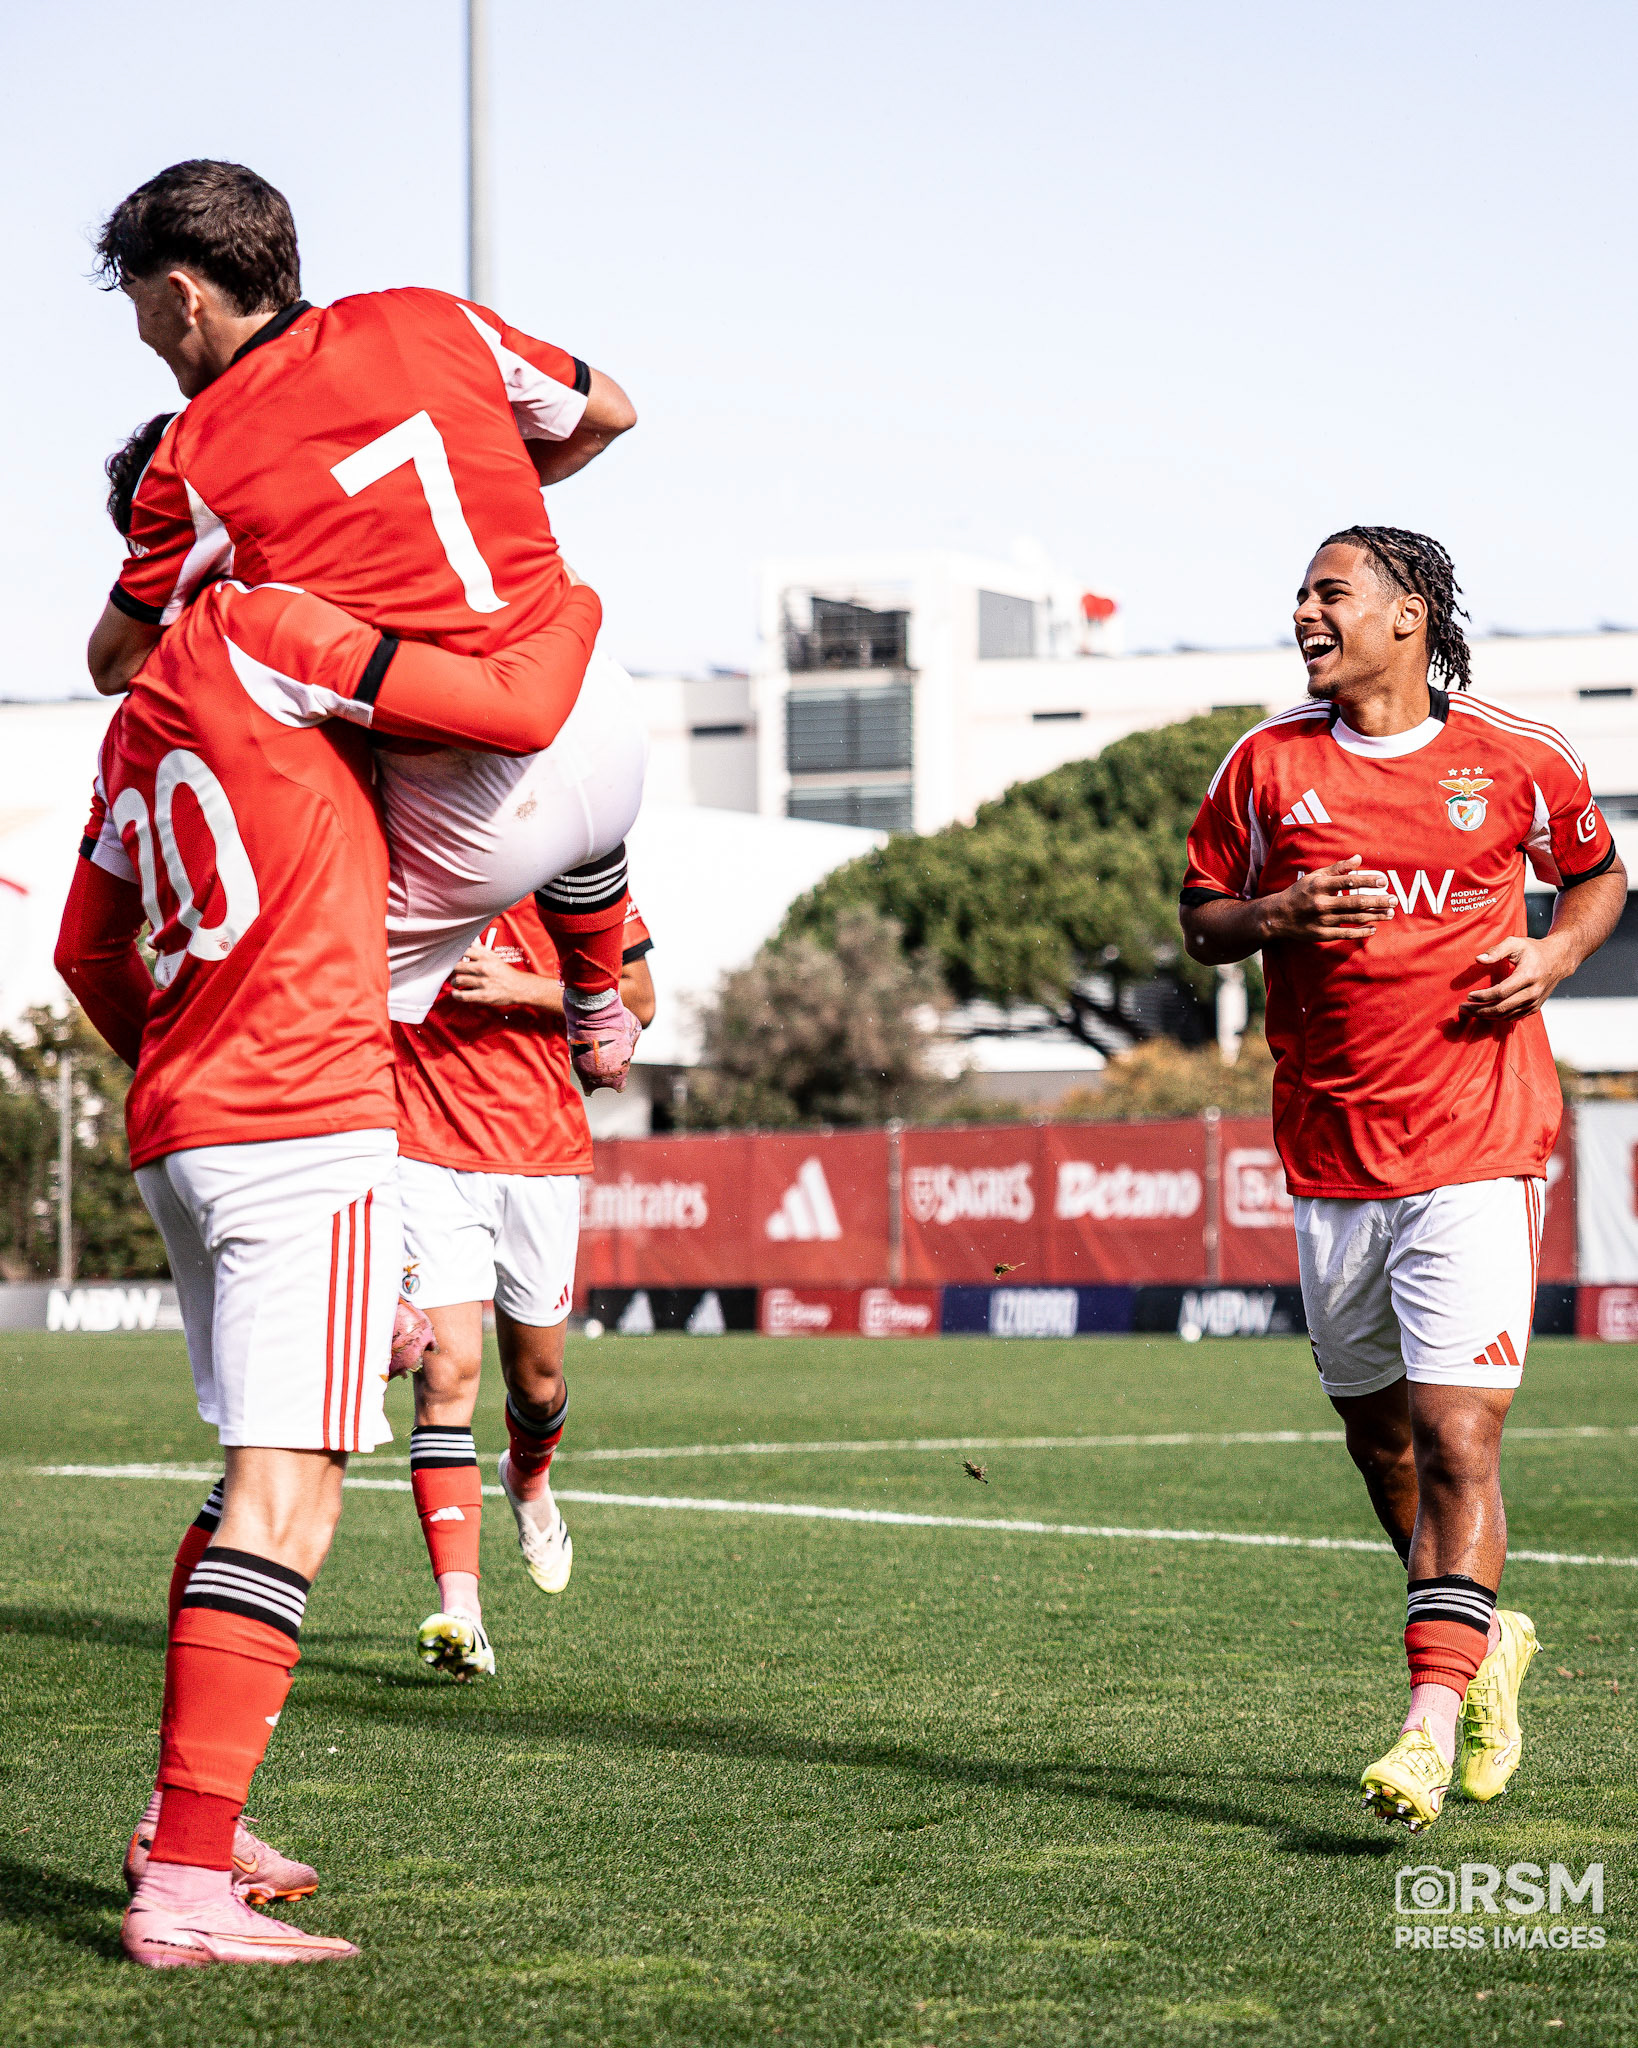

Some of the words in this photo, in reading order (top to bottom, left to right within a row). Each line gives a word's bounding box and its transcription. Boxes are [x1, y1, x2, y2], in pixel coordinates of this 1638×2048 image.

[330, 410, 510, 613] 7
[1451, 888, 1489, 898] MODULAR
[1451, 897, 1498, 912] WORLDWIDE
[1057, 1163, 1200, 1218] Betano
